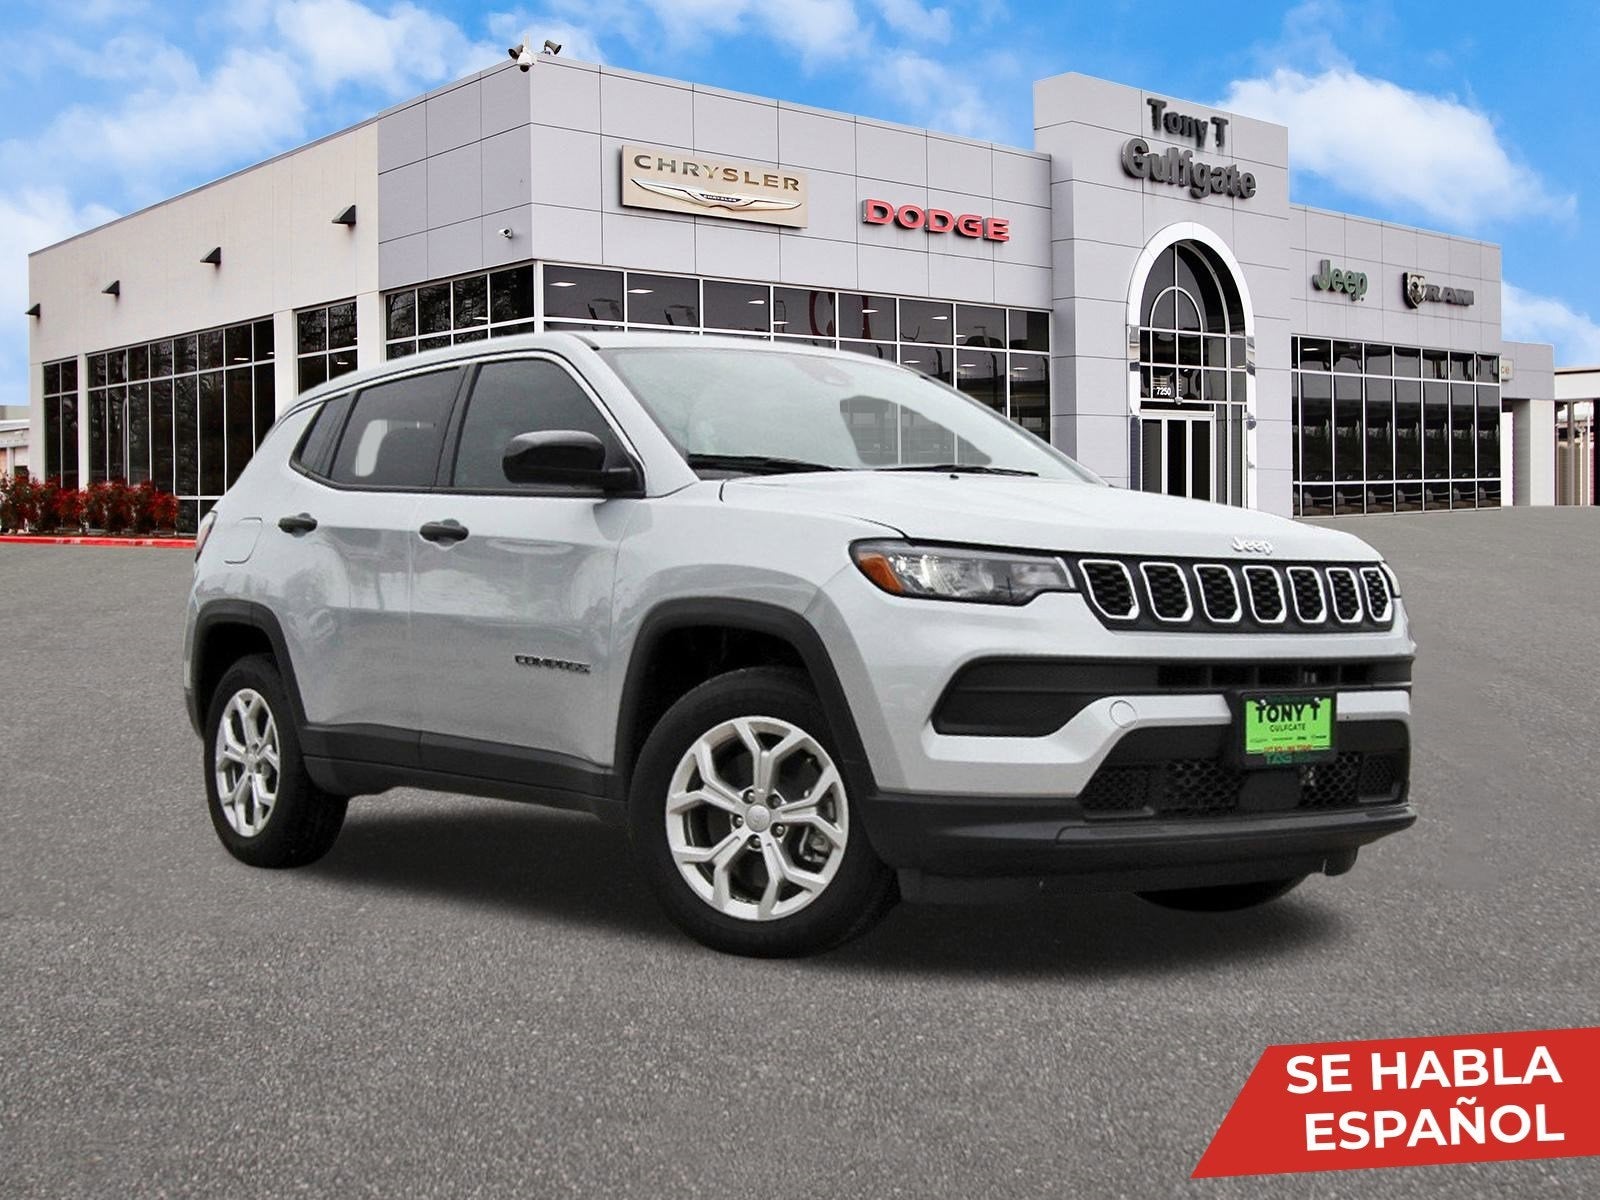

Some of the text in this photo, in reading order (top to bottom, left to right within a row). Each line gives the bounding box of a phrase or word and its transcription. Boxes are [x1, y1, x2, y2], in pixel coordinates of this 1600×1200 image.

[1146, 97, 1229, 148] Tony T
[633, 154, 801, 192] CHRYSLER
[1121, 137, 1257, 200] Gulfgate
[862, 198, 1010, 243] DODGE
[1312, 258, 1368, 301] Jeep
[1424, 284, 1475, 307] RAM
[1231, 536, 1273, 556] Jeep
[1256, 701, 1320, 723] TONY T
